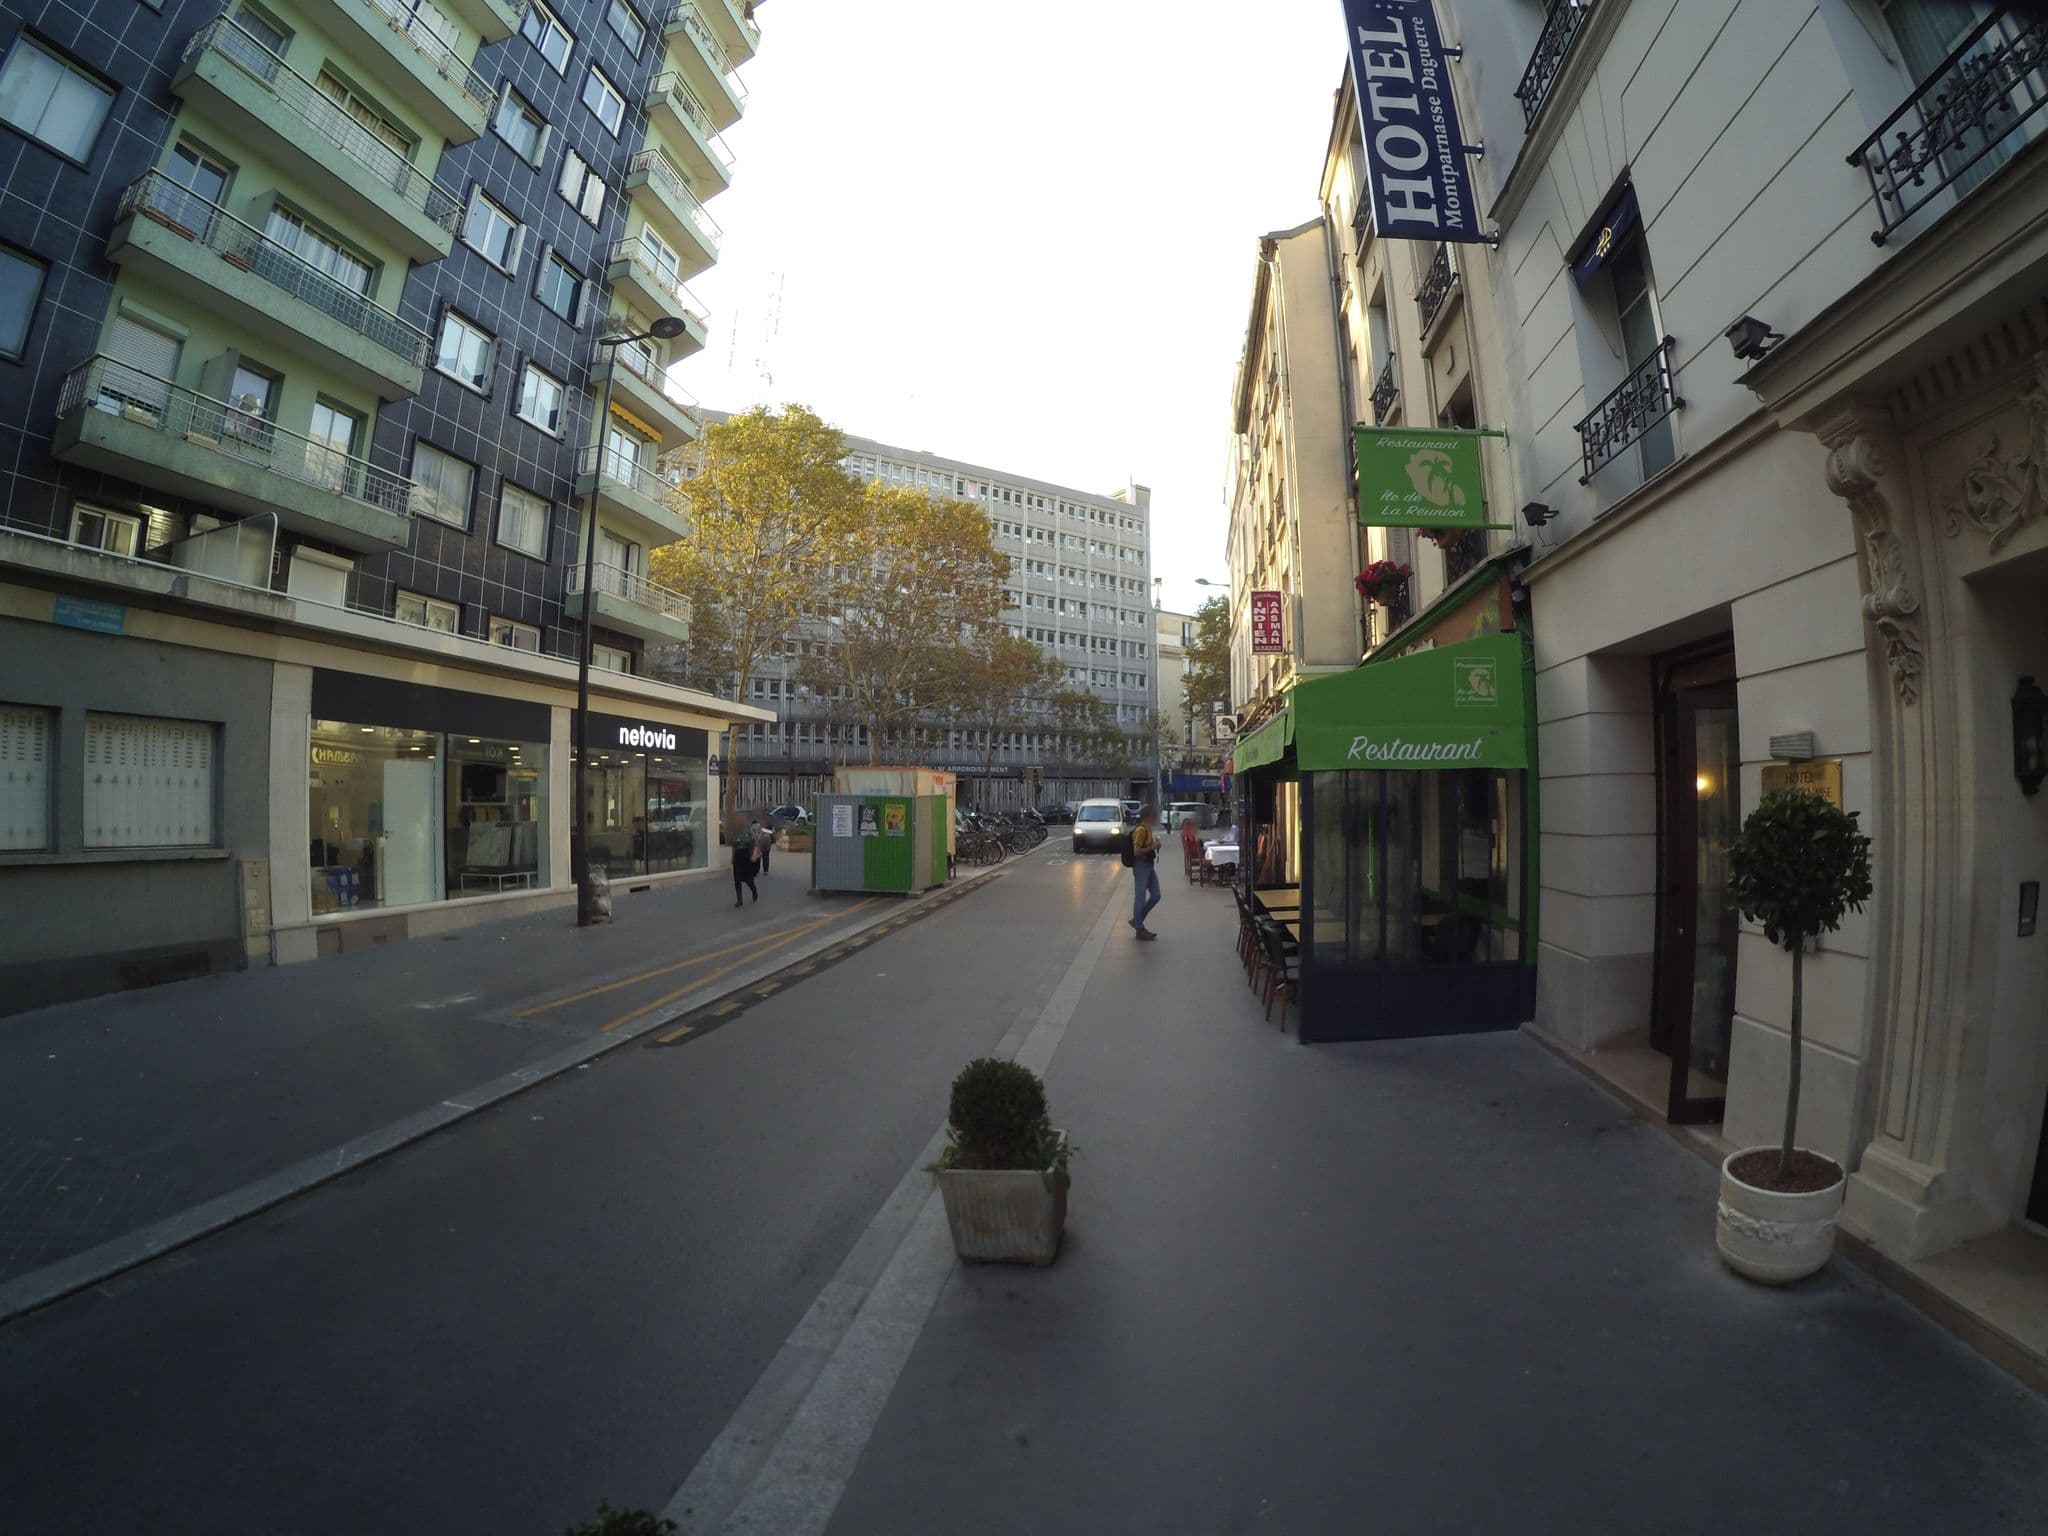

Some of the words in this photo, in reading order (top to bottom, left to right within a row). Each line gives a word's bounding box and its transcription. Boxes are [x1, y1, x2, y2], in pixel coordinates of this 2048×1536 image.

[1411, 16, 1438, 91] Daguerre
[1357, 16, 1440, 228] HOTEL
[1429, 96, 1464, 229] Montparnasse
[1375, 437, 1460, 449] Restaurant
[1403, 489, 1423, 503] de
[1381, 505, 1401, 516] La
[1405, 505, 1466, 517] Réunion
[1253, 601, 1268, 645] INDIEN
[1270, 601, 1281, 645] AASMAN
[619, 725, 676, 750] netovia
[1347, 735, 1483, 761] Restaurant
[947, 765, 1009, 773] ARRONDISSMENT
